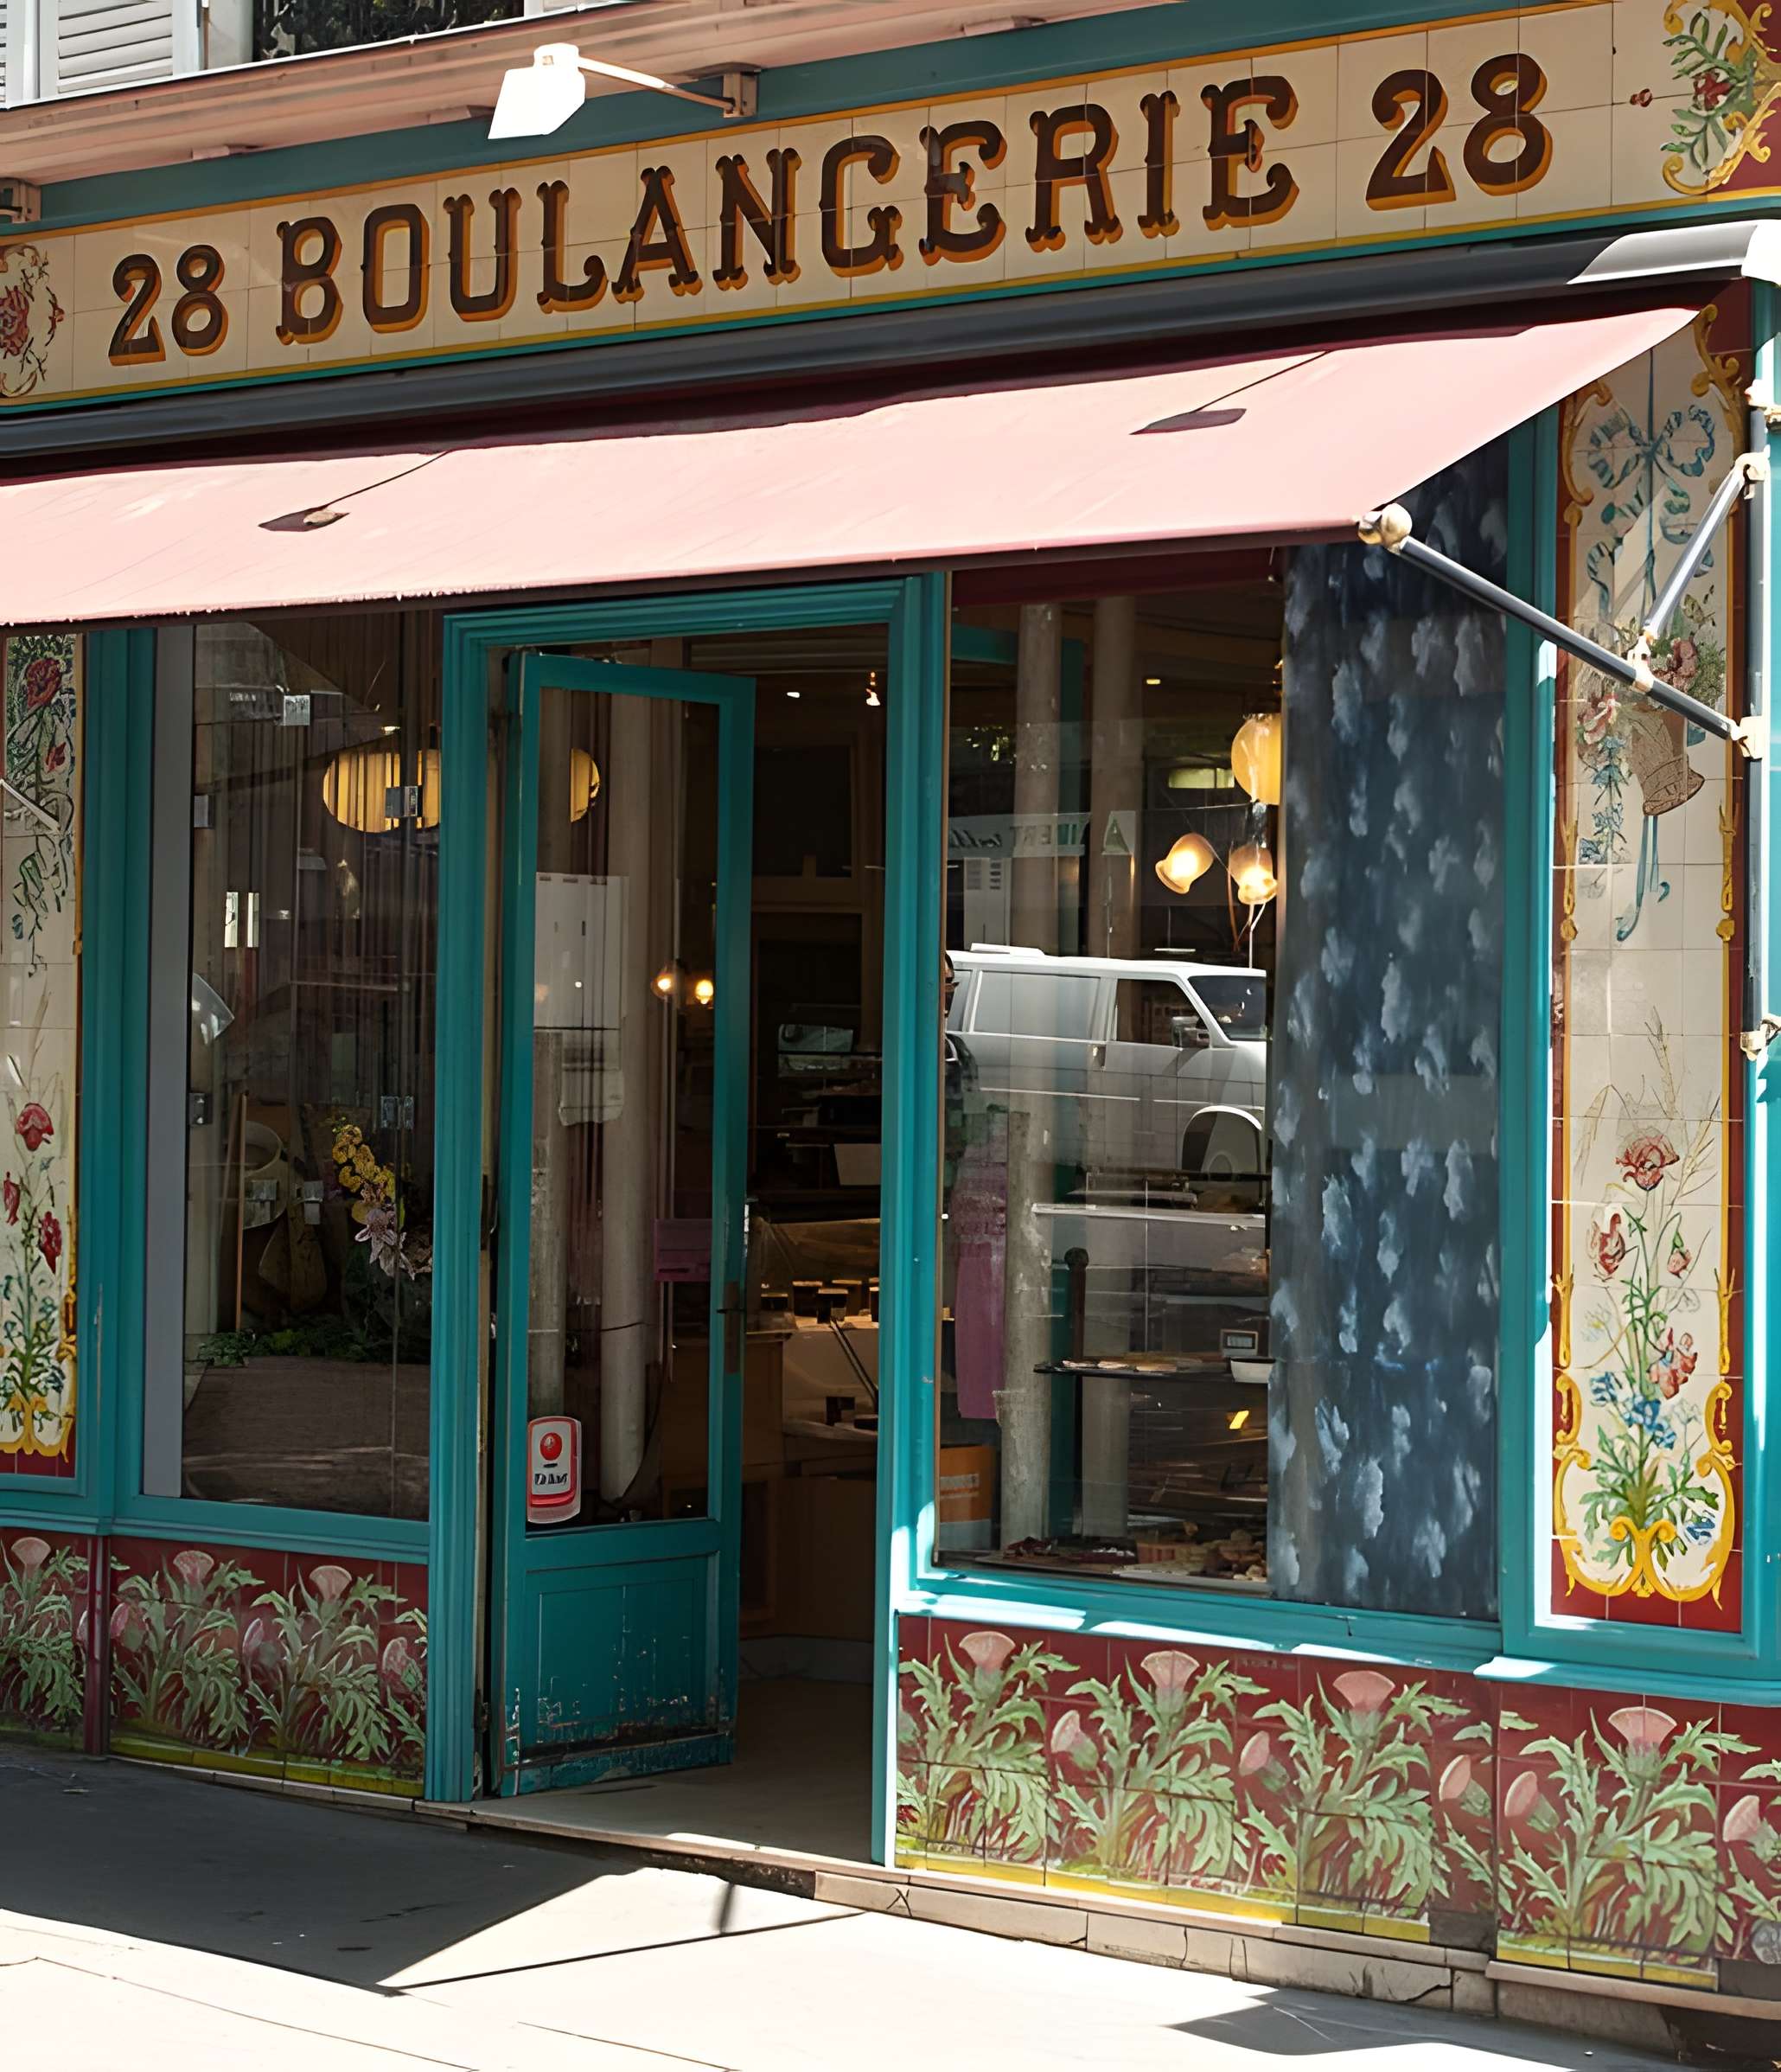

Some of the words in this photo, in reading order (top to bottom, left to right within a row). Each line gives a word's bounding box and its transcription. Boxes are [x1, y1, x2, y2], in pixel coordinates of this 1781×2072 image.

[108, 245, 229, 366] 28
[275, 75, 1300, 344] BOULANGERIE
[1365, 53, 1554, 211] 28
